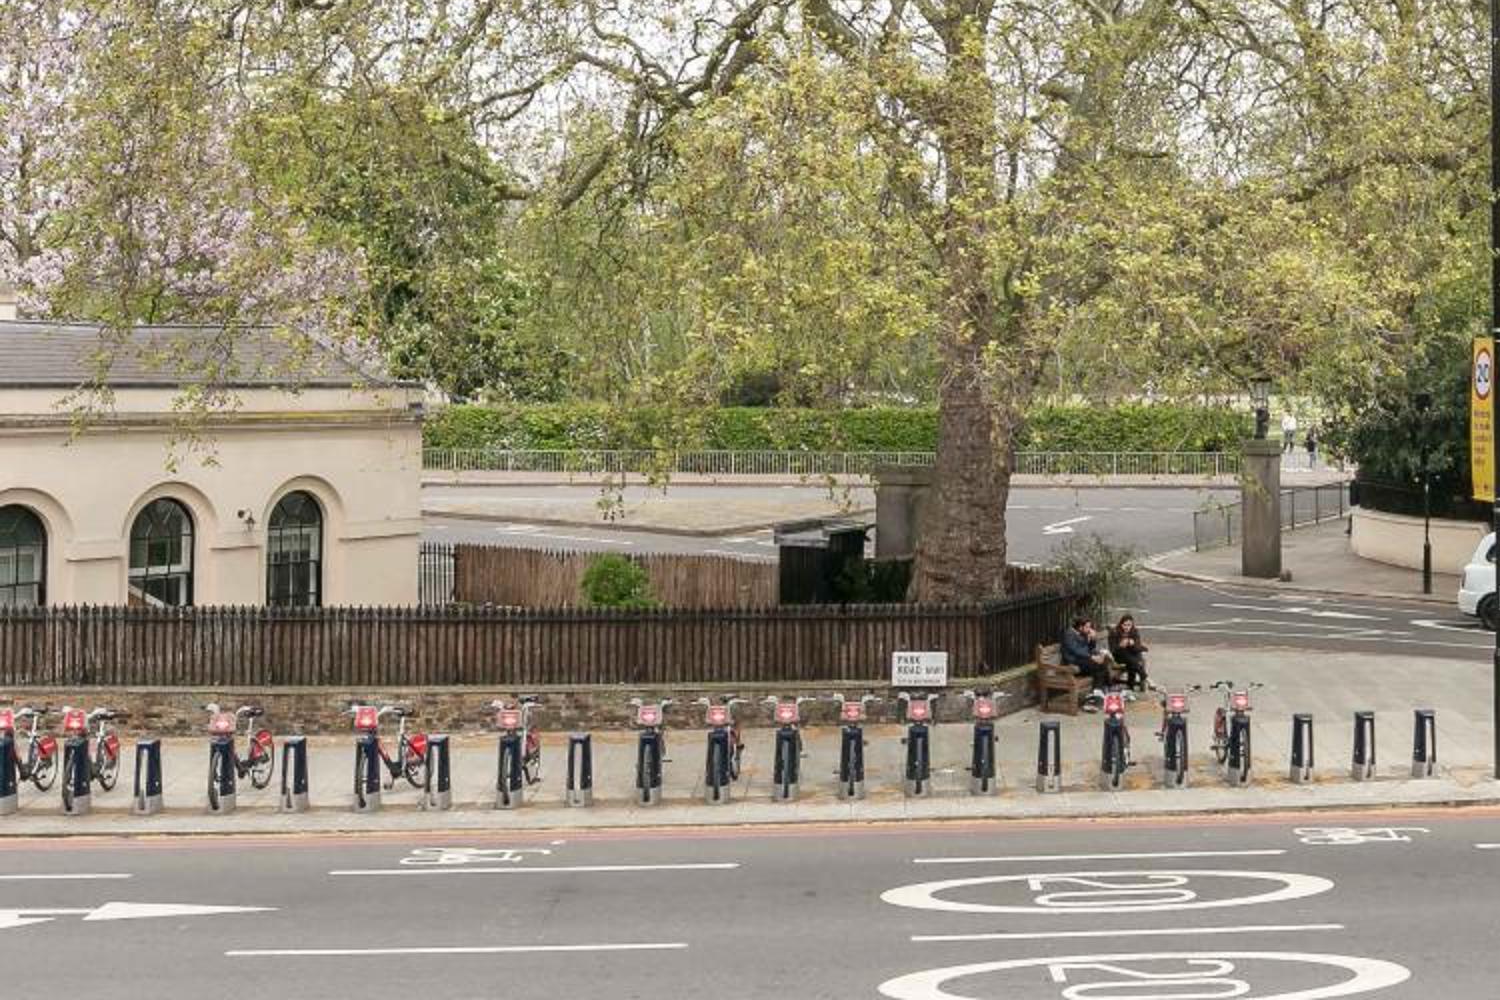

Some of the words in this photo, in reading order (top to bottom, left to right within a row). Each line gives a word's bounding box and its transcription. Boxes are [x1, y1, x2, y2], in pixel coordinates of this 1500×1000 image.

[1477, 363, 1489, 383] 20
[897, 655, 921, 665] PARK
[897, 665, 921, 675] ROAD
[1027, 874, 1197, 907] 20
[1049, 959, 1251, 1000] 20
